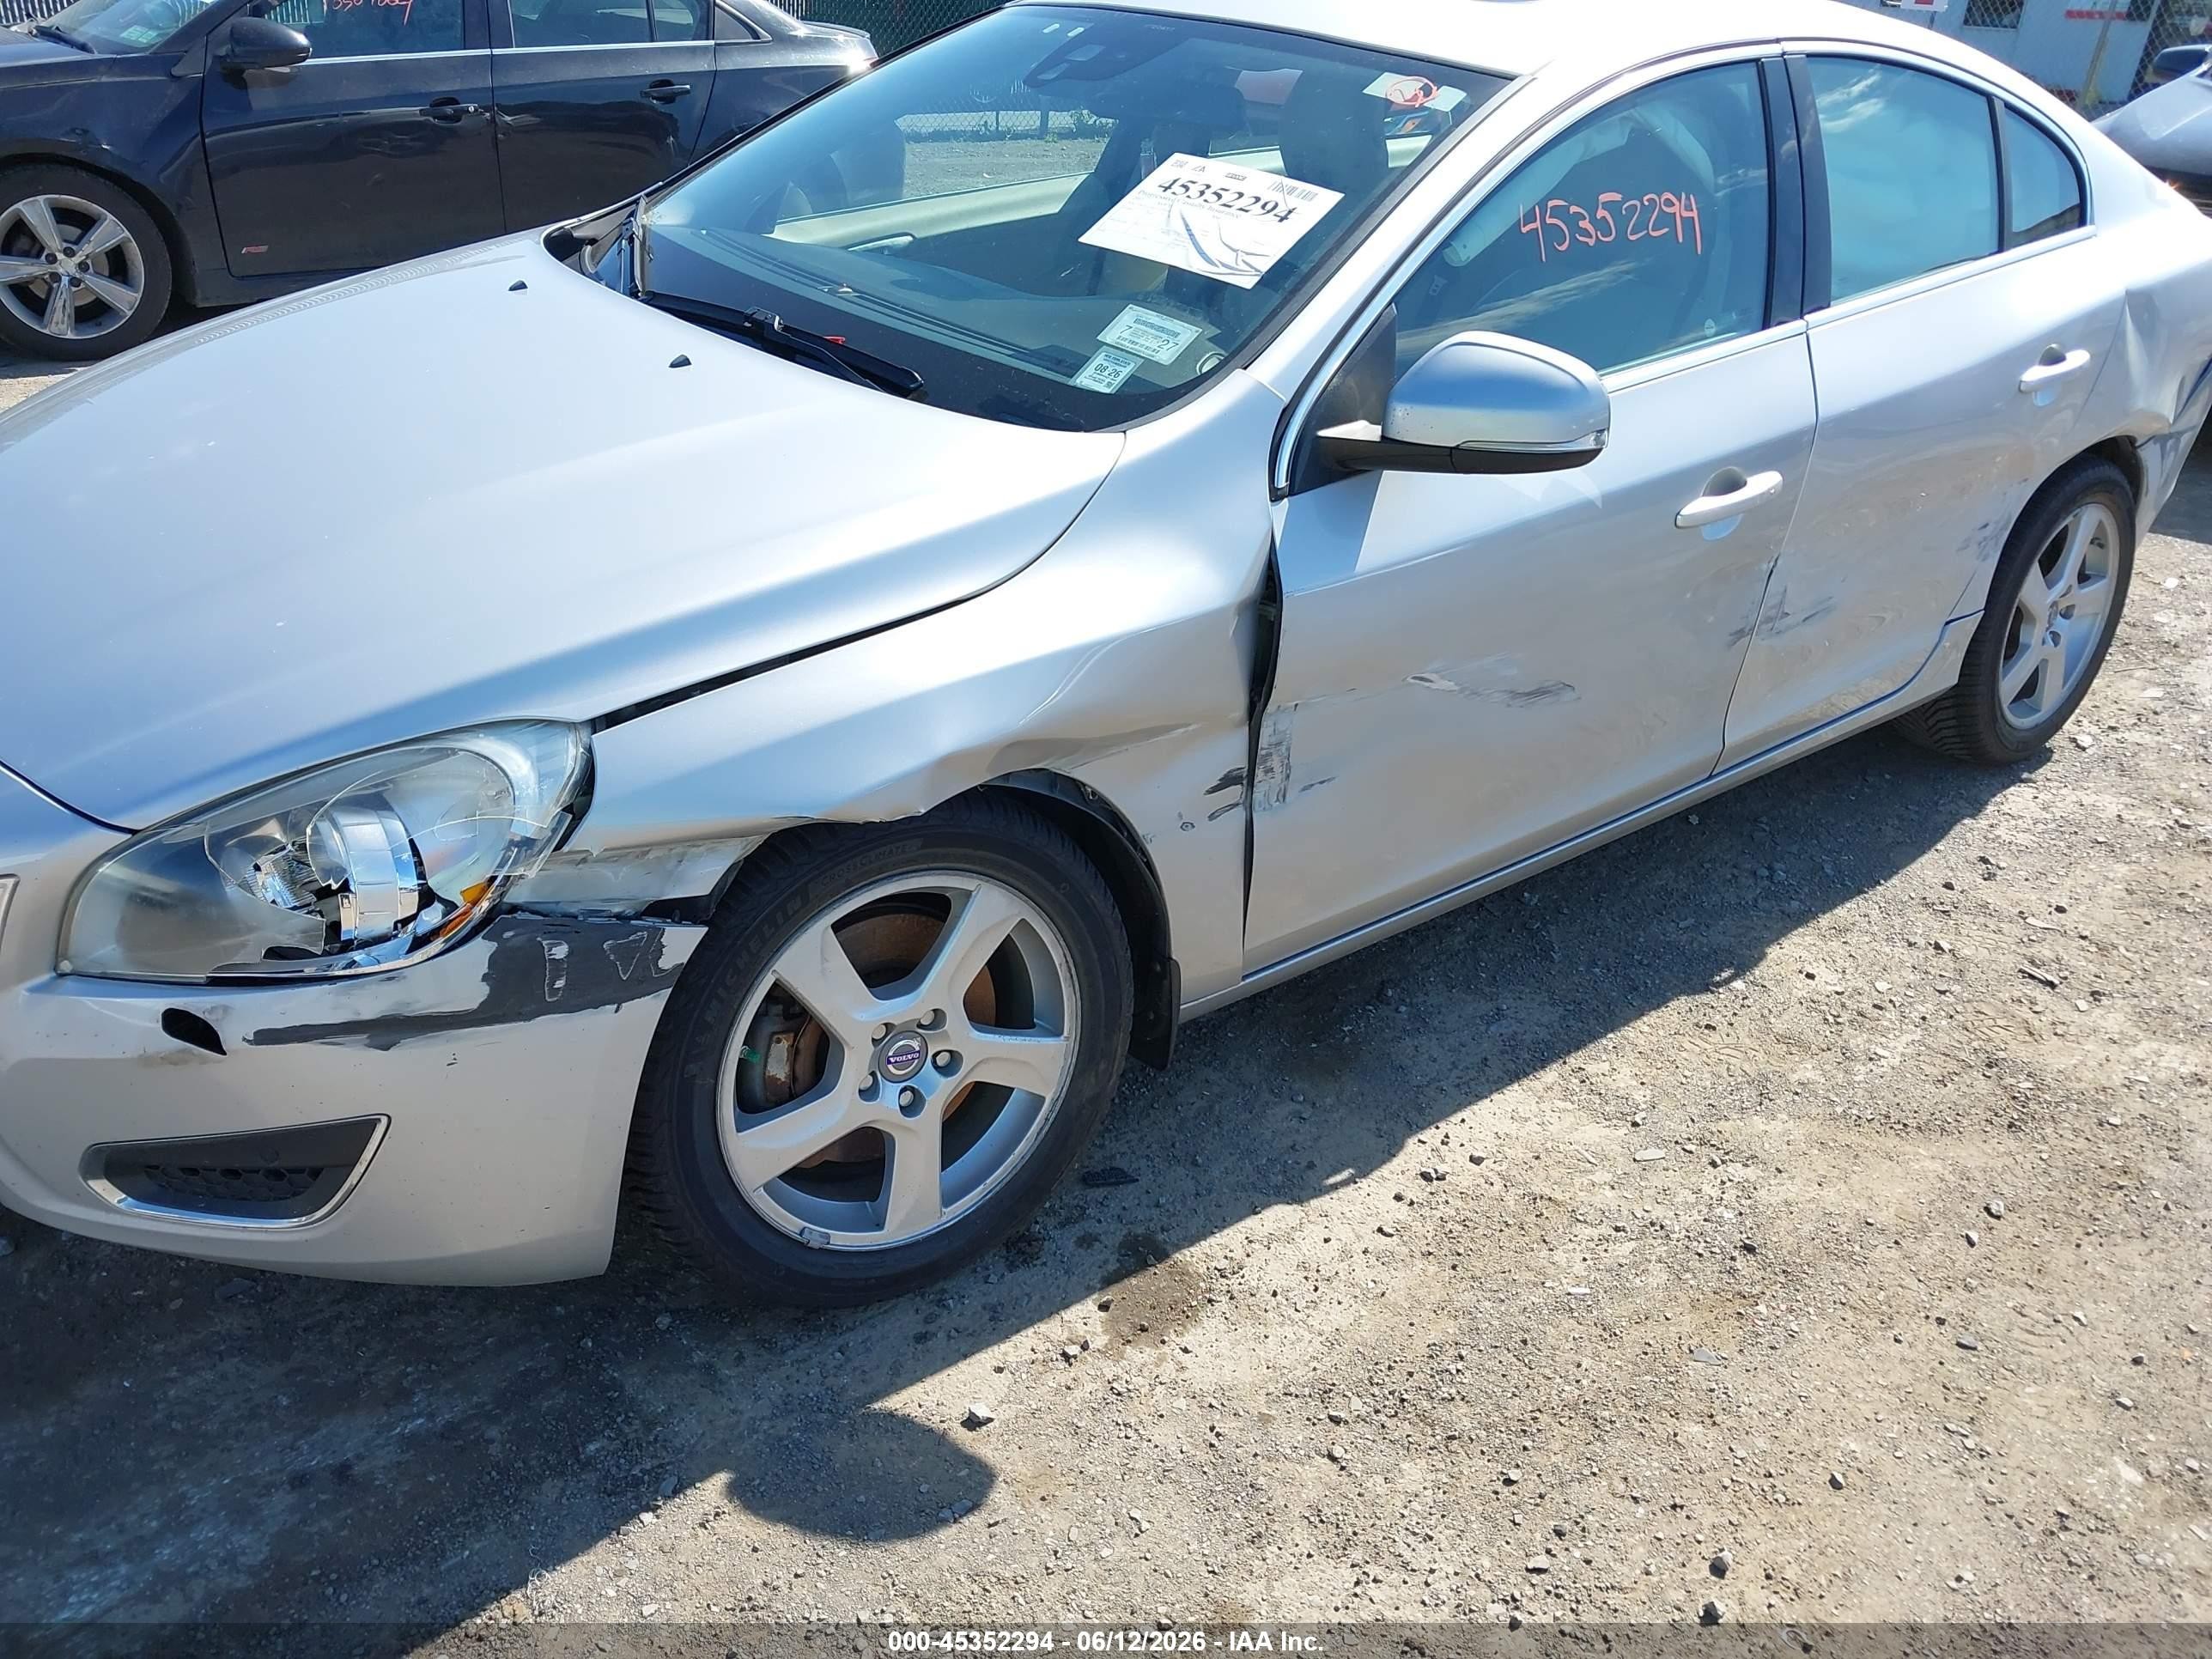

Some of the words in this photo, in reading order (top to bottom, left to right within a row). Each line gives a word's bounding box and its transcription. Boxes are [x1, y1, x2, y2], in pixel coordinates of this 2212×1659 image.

[1158, 177, 1297, 223] 45352294
[1519, 191, 1702, 262] 45352294
[1119, 325, 1133, 335] 7
[1157, 338, 1180, 351] 27
[889, 1052, 920, 1063] VOLVO
